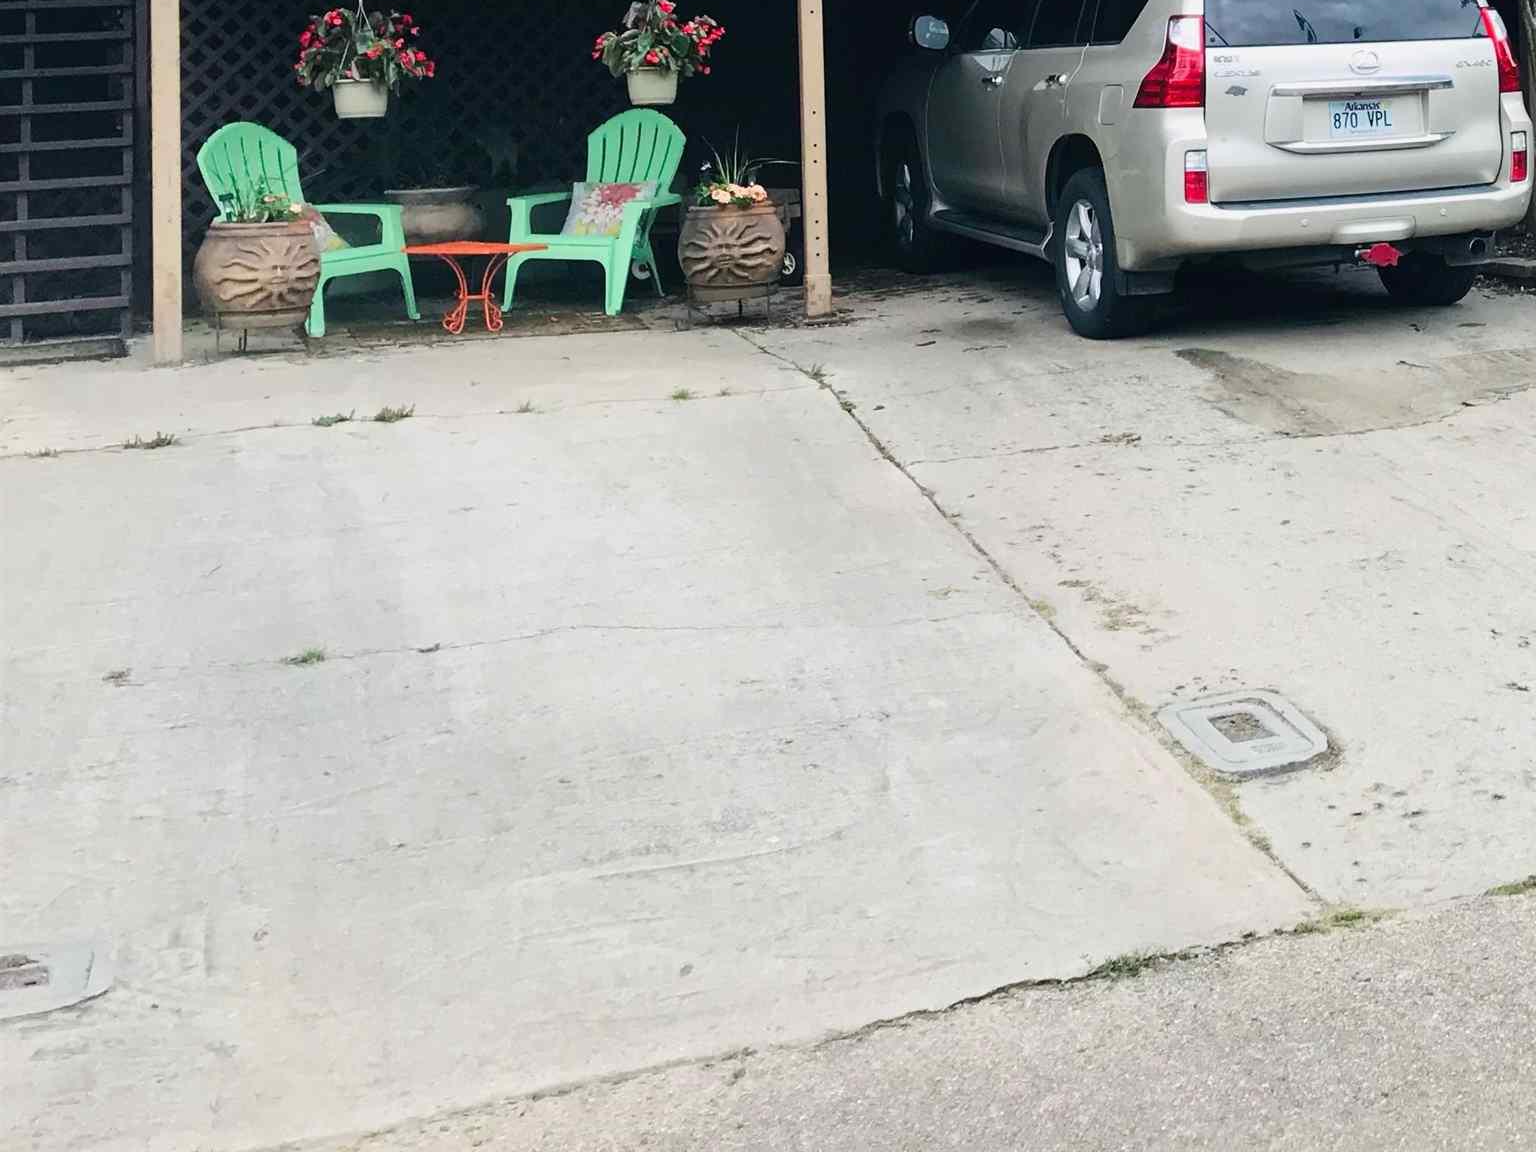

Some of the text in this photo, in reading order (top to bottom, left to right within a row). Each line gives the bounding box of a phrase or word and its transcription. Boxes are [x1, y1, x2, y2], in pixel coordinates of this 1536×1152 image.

[1344, 101, 1381, 111] Arkansas
[1333, 110, 1392, 129] 870 VPL
